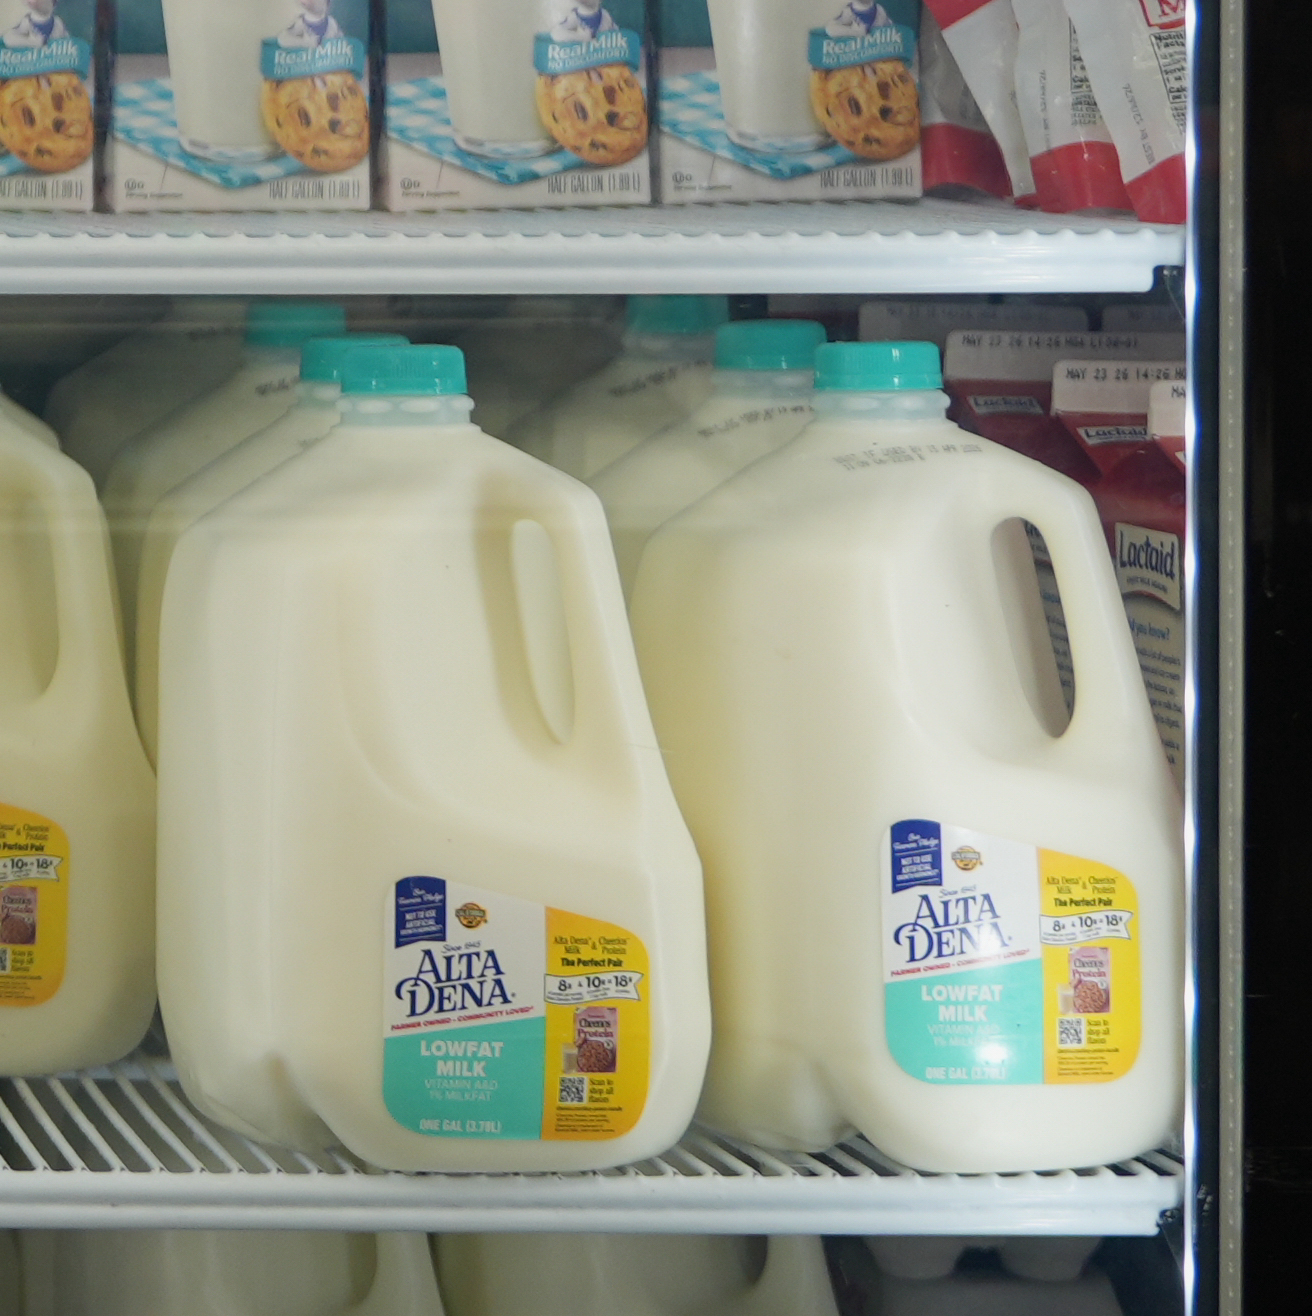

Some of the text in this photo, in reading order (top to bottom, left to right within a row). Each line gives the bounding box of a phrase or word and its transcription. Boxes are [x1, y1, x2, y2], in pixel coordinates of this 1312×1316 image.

[1118, 530, 1176, 578] Lactaid
[911, 893, 1001, 931] ALTA
[894, 922, 1009, 963] DENA
[415, 949, 505, 984] ALTA
[395, 978, 513, 1017] DENA
[921, 986, 1003, 1001] LOWFAT
[939, 1005, 987, 1021] MILK
[420, 1041, 504, 1057] LOWFAT
[436, 1060, 486, 1077] MILK
